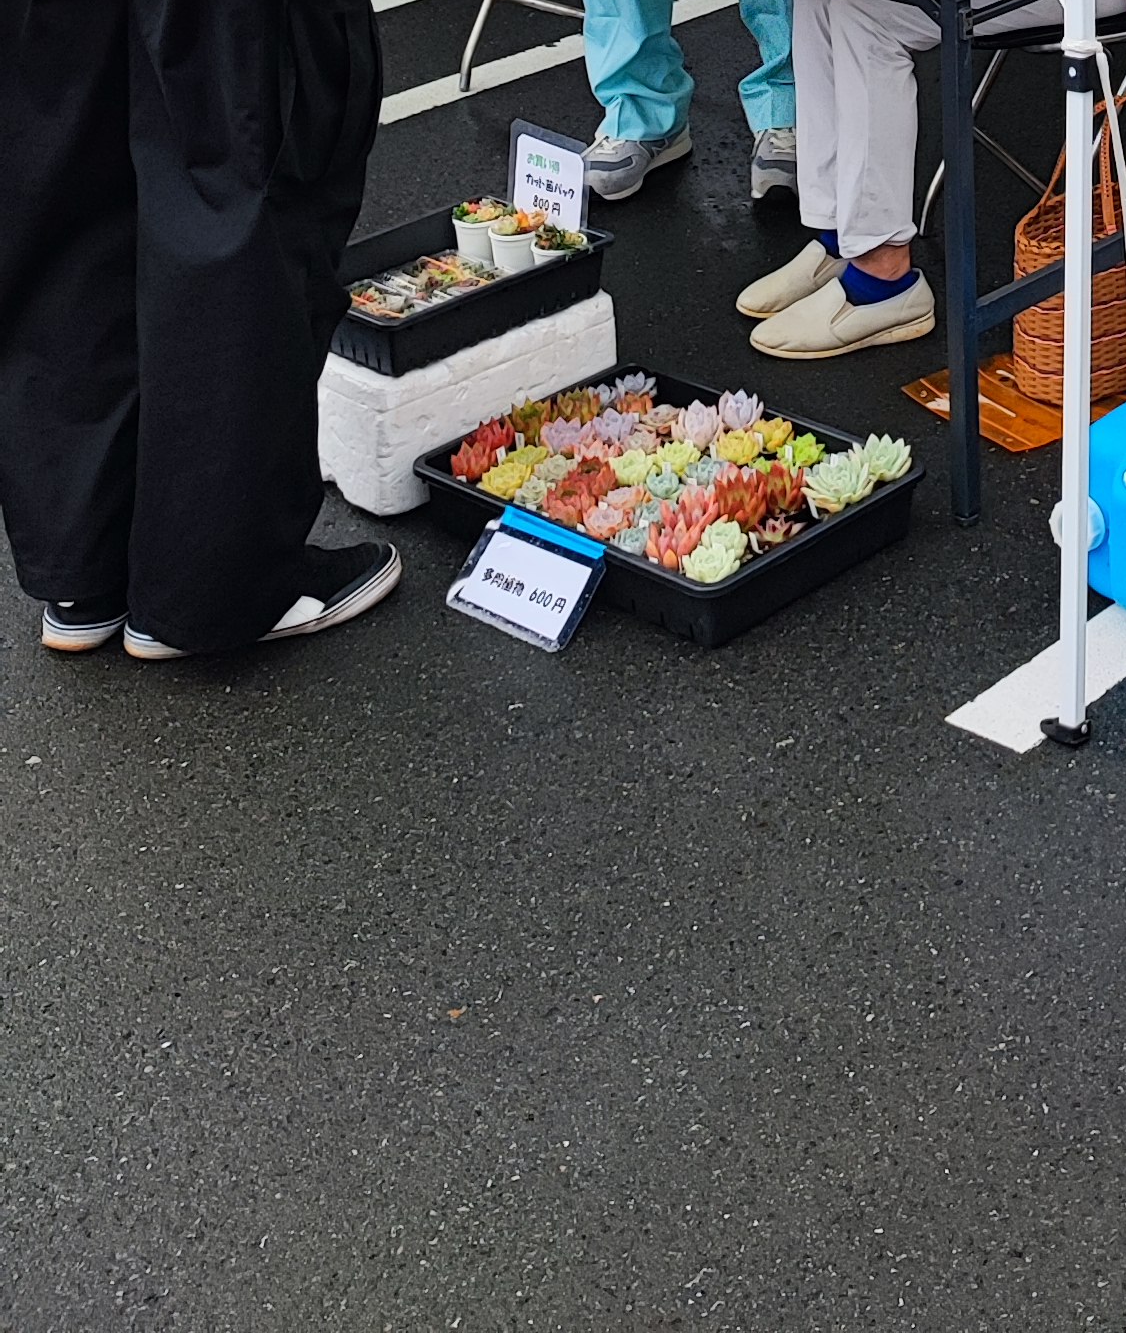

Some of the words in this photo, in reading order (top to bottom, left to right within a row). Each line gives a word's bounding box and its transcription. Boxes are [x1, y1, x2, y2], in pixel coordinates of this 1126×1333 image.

[532, 194, 561, 217] 800円
[482, 567, 525, 598] 多肉植物
[528, 587, 567, 614] 600円
